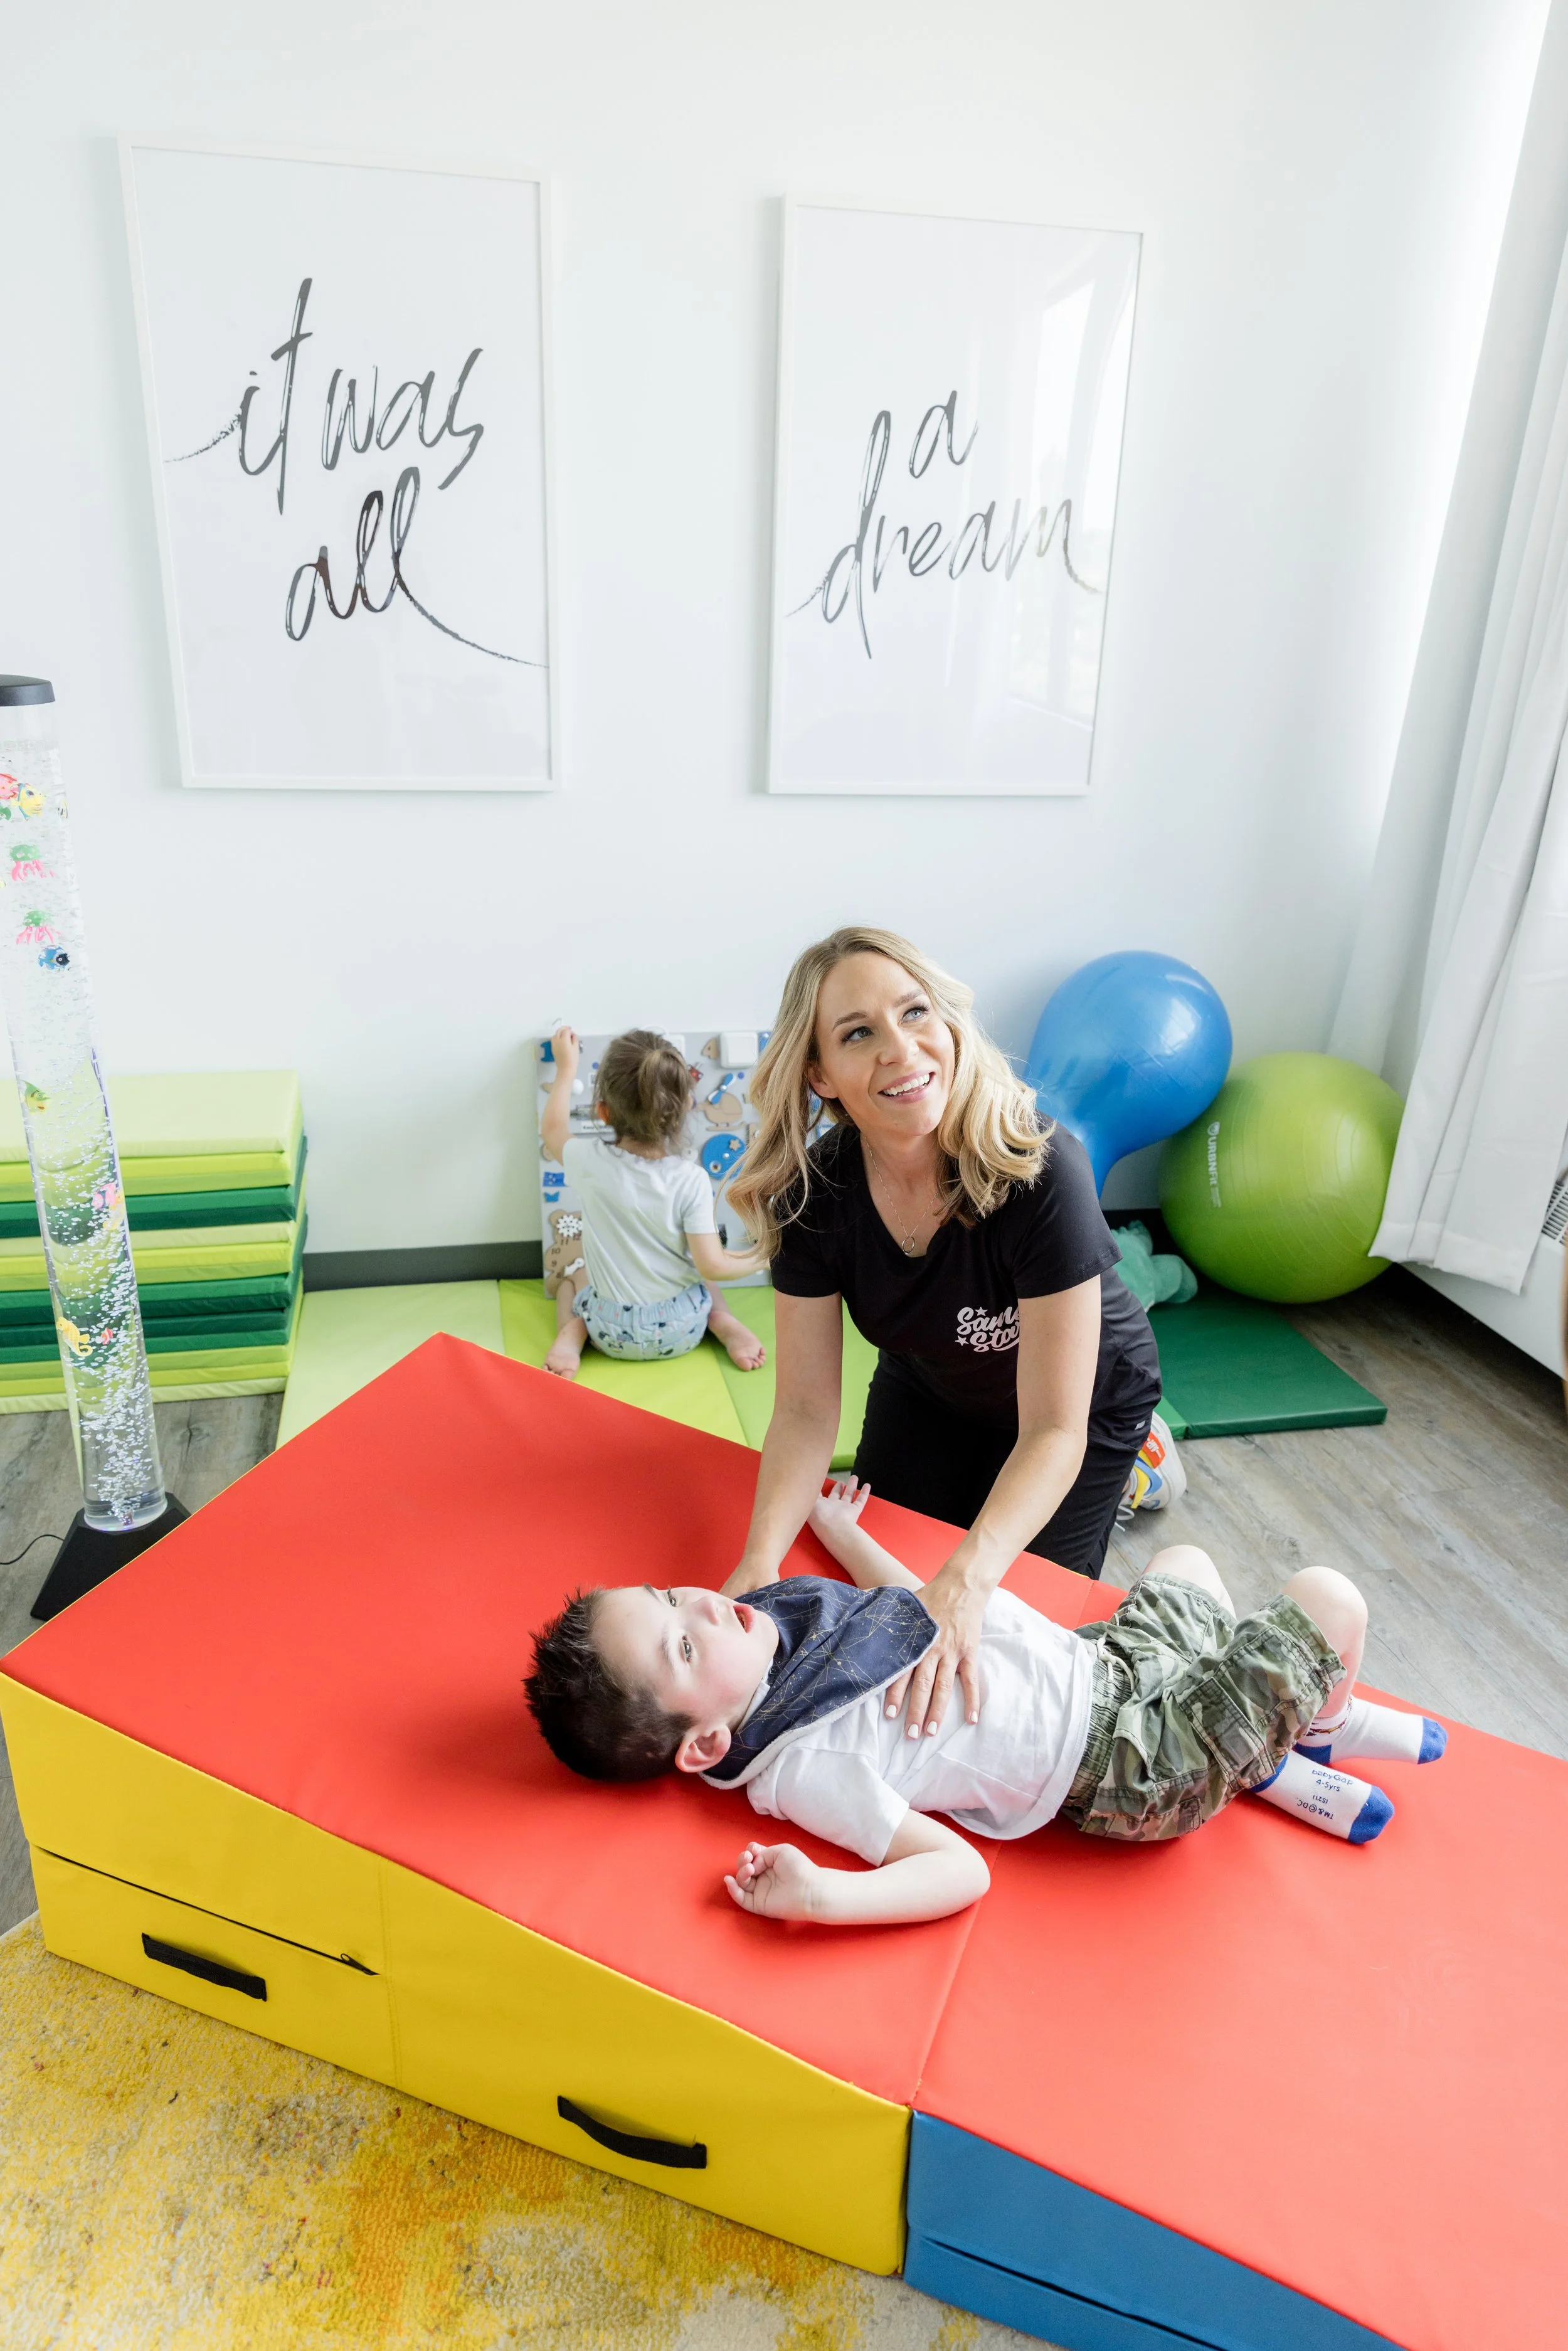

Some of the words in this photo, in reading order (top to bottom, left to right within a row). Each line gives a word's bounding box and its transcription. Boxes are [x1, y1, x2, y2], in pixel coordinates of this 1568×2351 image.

[164, 278, 314, 515] it
[322, 348, 484, 490] was
[909, 390, 978, 479] a
[285, 467, 549, 668] all
[786, 410, 1105, 659] dream
[1311, 1770, 1353, 1785] babyGap
[1316, 1779, 1340, 1791] 4-5yrs
